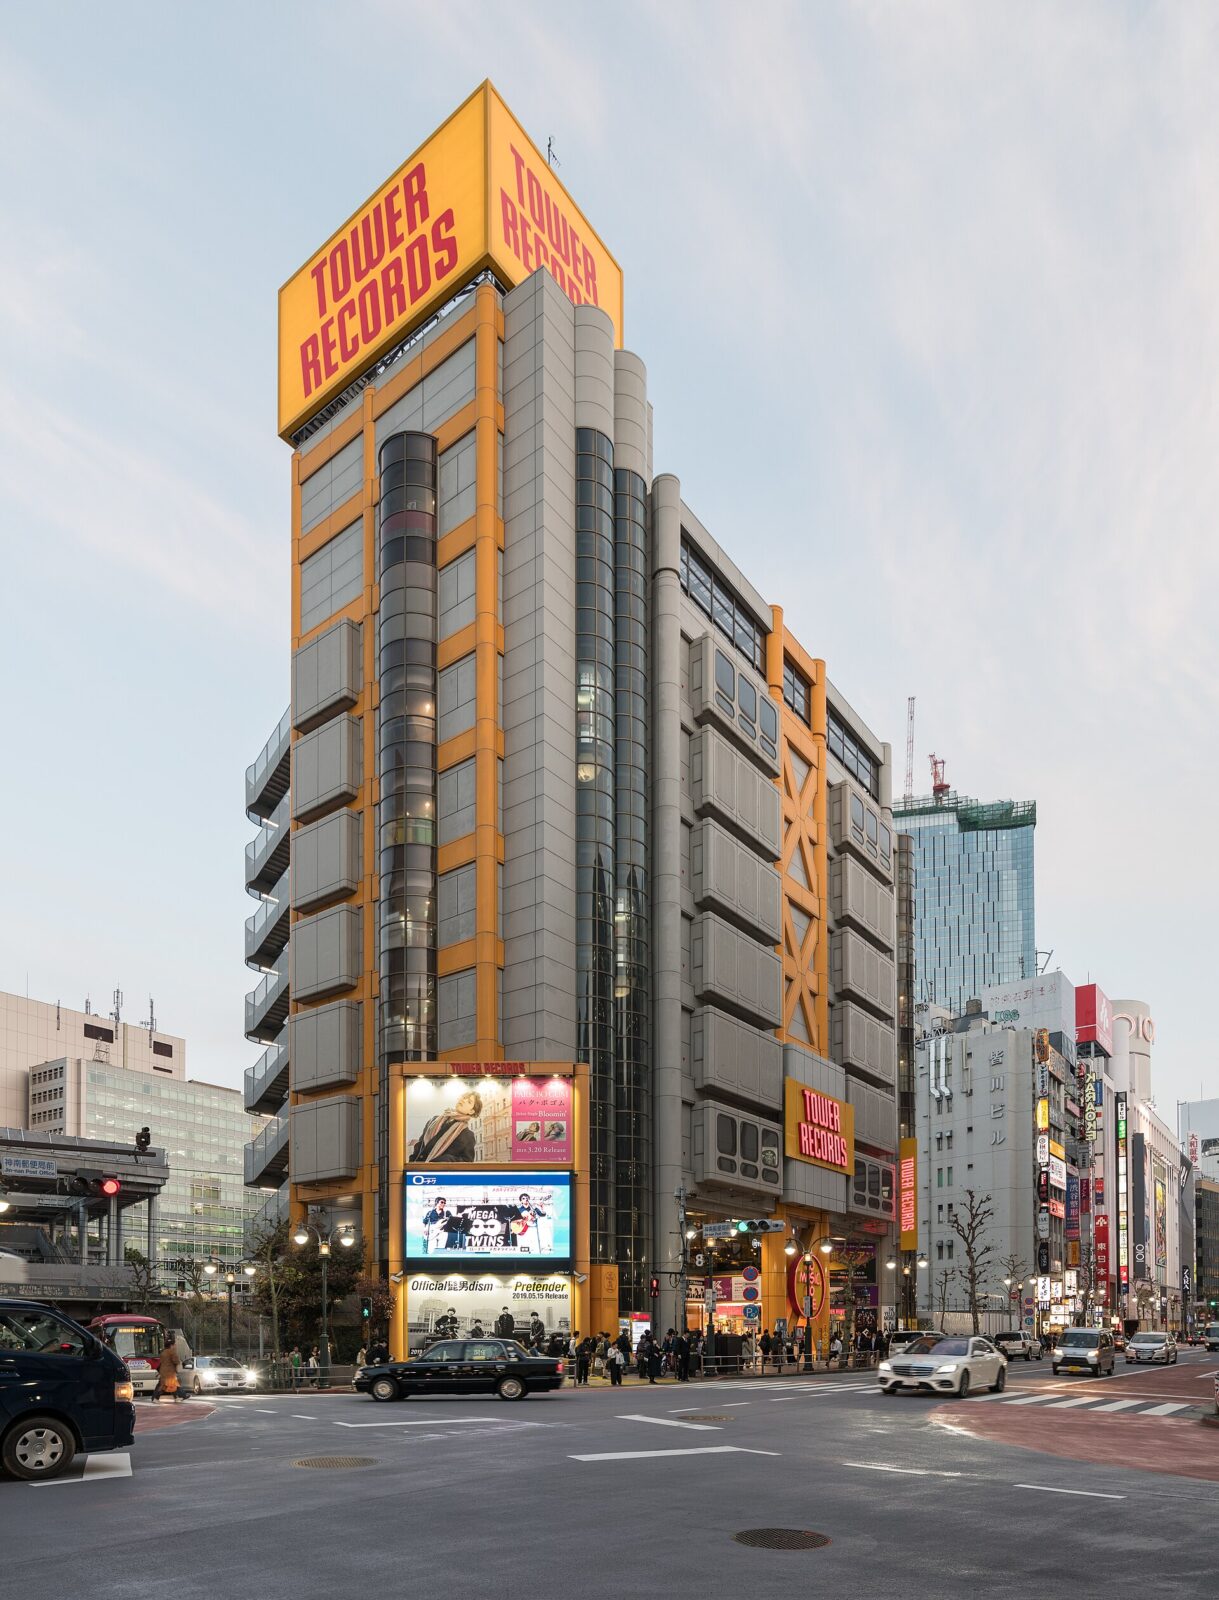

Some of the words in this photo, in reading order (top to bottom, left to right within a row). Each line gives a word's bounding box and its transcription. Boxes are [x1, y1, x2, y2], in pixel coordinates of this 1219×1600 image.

[311, 162, 430, 320] TOWER
[510, 142, 598, 304] TOWER
[300, 208, 458, 399] RECORDS
[451, 1063, 482, 1074] TOWER
[484, 1063, 526, 1074] RECORDS
[802, 1088, 841, 1133] TOWER
[1085, 1072, 1097, 1141] KARAOKE
[799, 1121, 848, 1167] RECORDS
[901, 1156, 914, 1189] TOWER
[901, 1191, 914, 1232] RECORDS
[466, 1235, 505, 1247] TWINS
[512, 1292, 544, 1300] 2019.05.15
[545, 1292, 569, 1300] Release
[514, 1281, 567, 1292] Pretender
